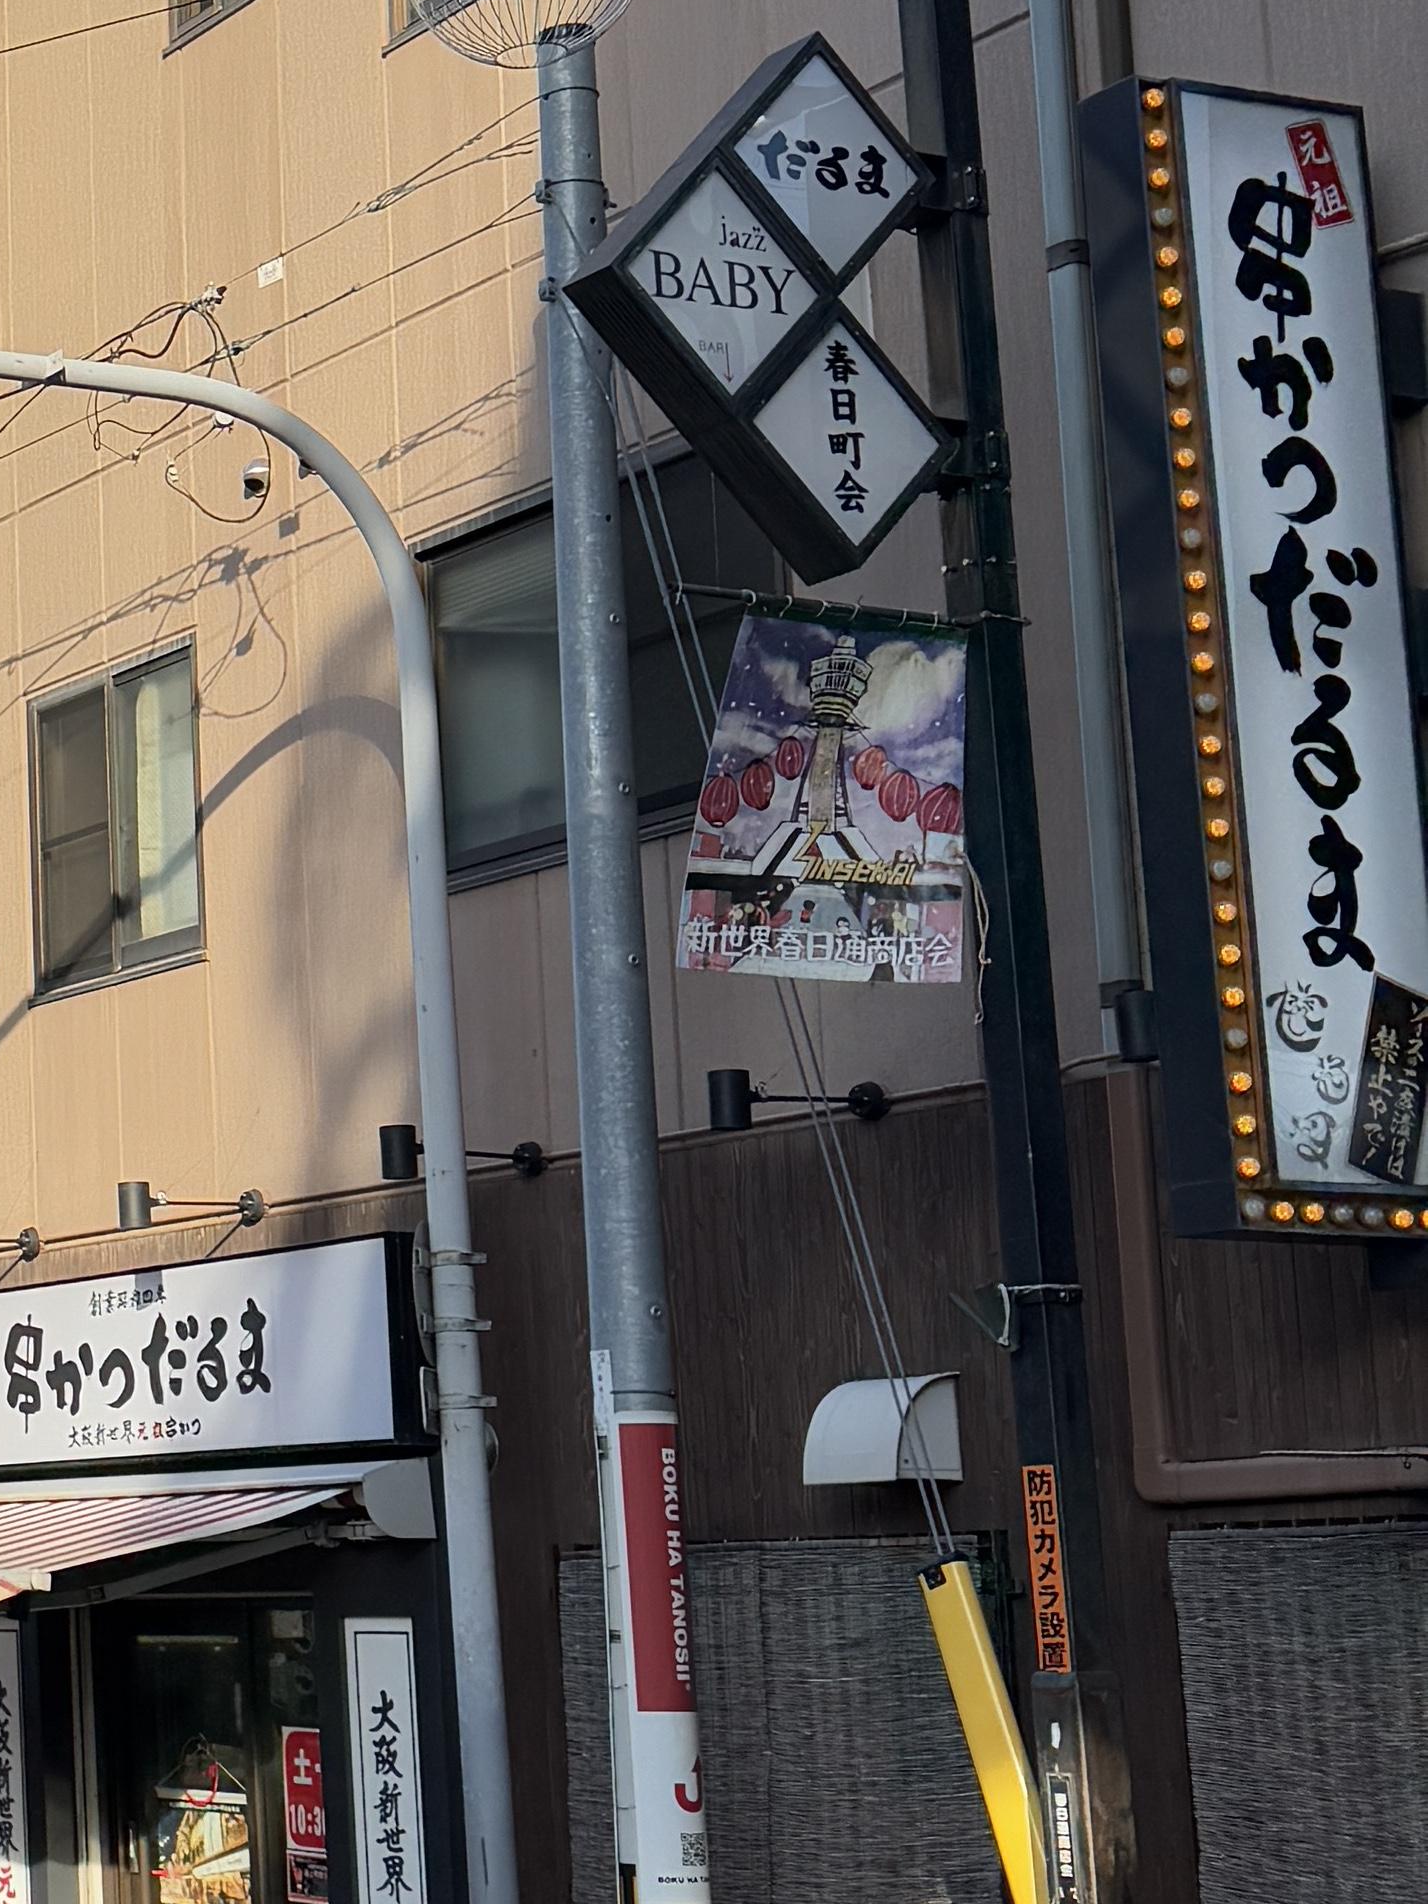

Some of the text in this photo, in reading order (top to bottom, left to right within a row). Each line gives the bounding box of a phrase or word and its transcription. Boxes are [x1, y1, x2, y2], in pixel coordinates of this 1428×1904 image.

[757, 129, 891, 199] だるま
[1299, 129, 1348, 219] 元祖
[648, 249, 797, 316] BABY
[698, 340, 725, 354] BAR
[823, 339, 870, 514] 春日町会
[1227, 170, 1378, 972] 串かつだるま
[684, 915, 955, 968] 新世界春日通商店会
[4, 1298, 271, 1434] 串かつだるま
[662, 1448, 691, 1682] BOKU HA TANOSII
[1027, 1469, 1066, 1669] 防犯カメラ設置
